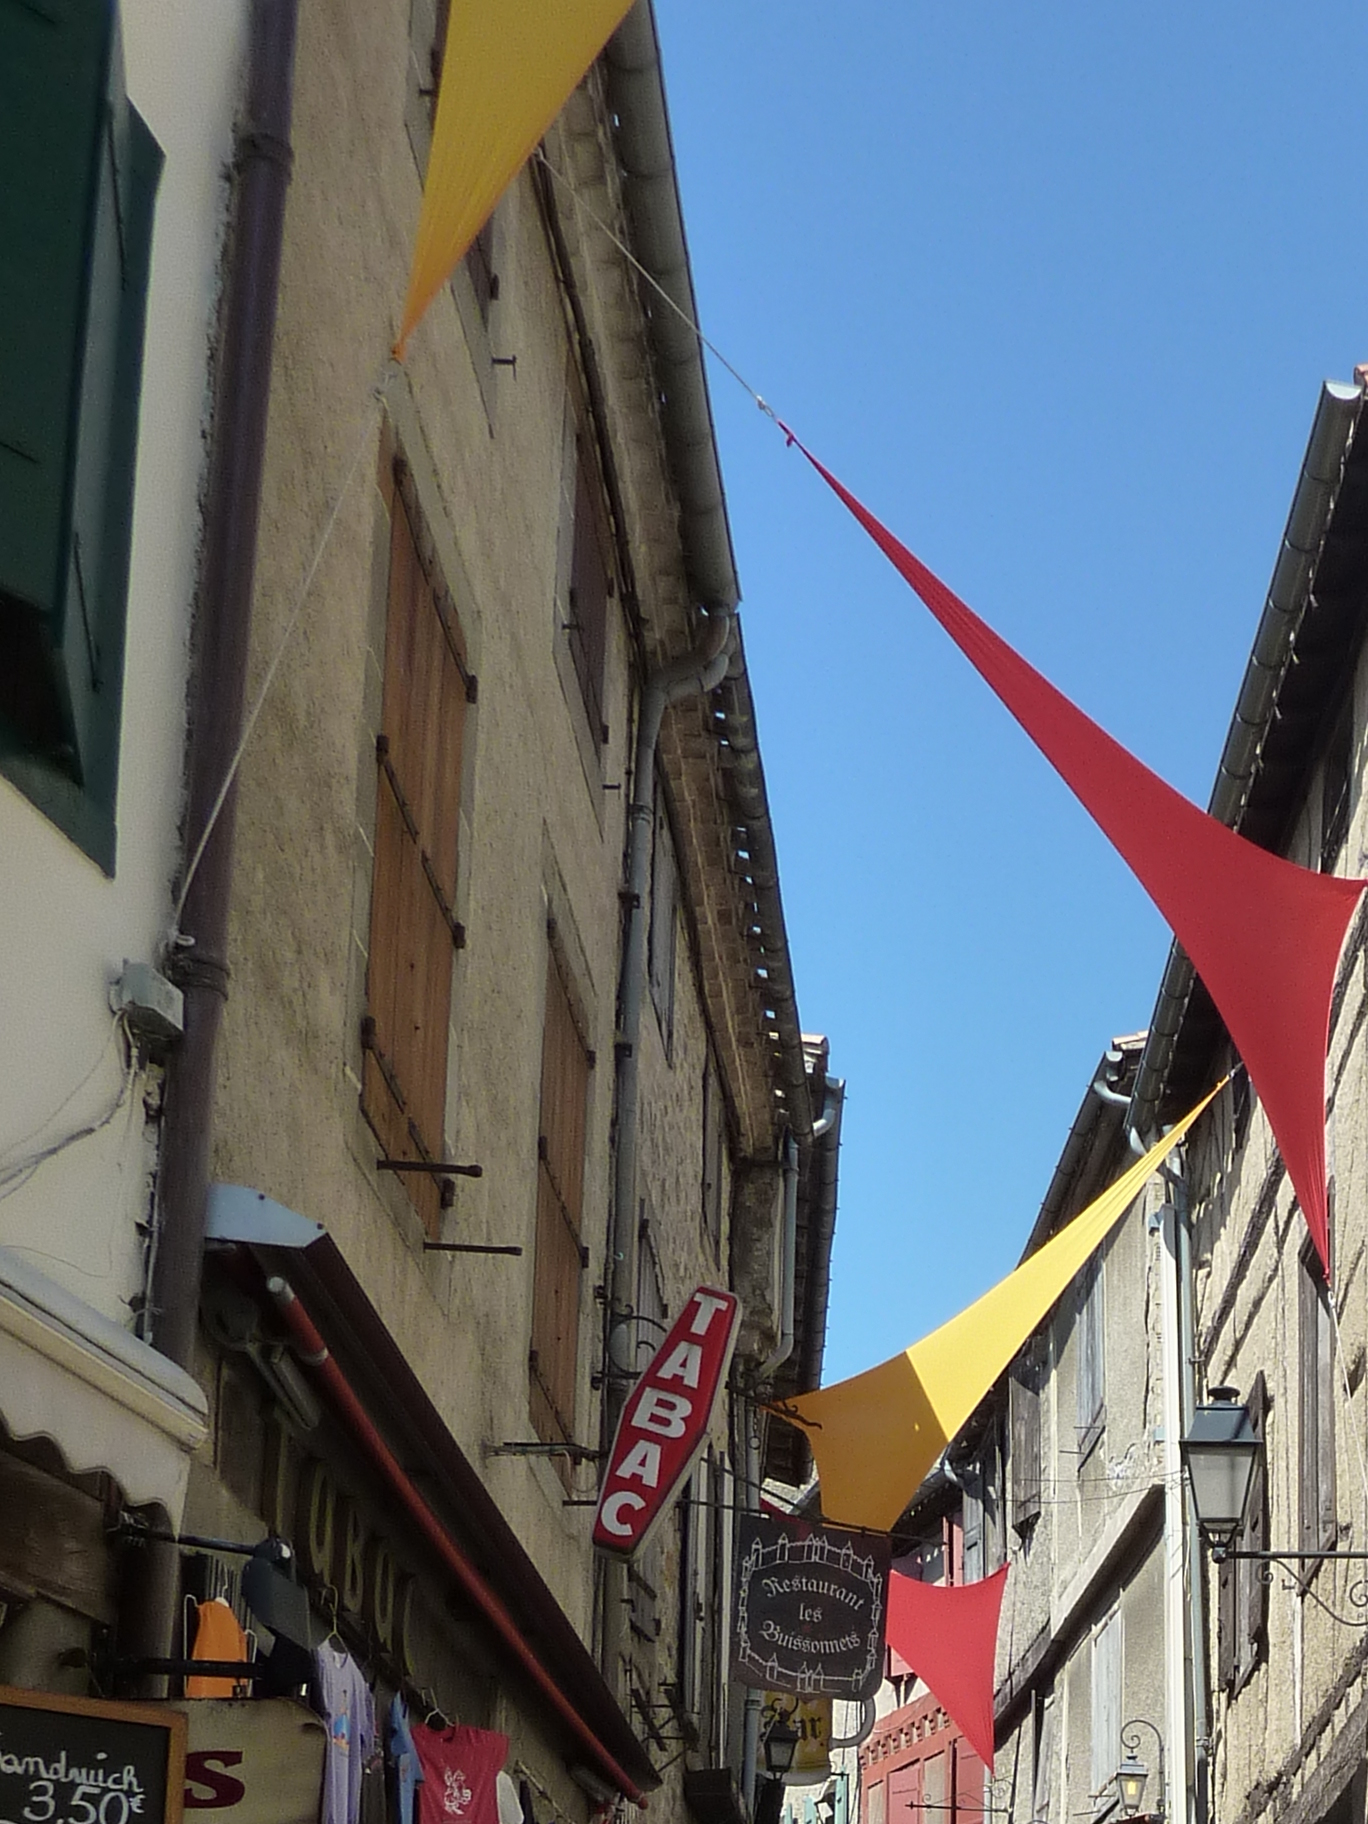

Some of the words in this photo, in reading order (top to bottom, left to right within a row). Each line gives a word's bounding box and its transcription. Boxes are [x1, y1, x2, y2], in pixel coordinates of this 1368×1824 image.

[601, 1291, 729, 1537] TABAC
[762, 1575, 864, 1611] Restaurant
[799, 1602, 823, 1623] les
[758, 1619, 862, 1655] Buissonnets
[0, 1750, 143, 1793] andwich
